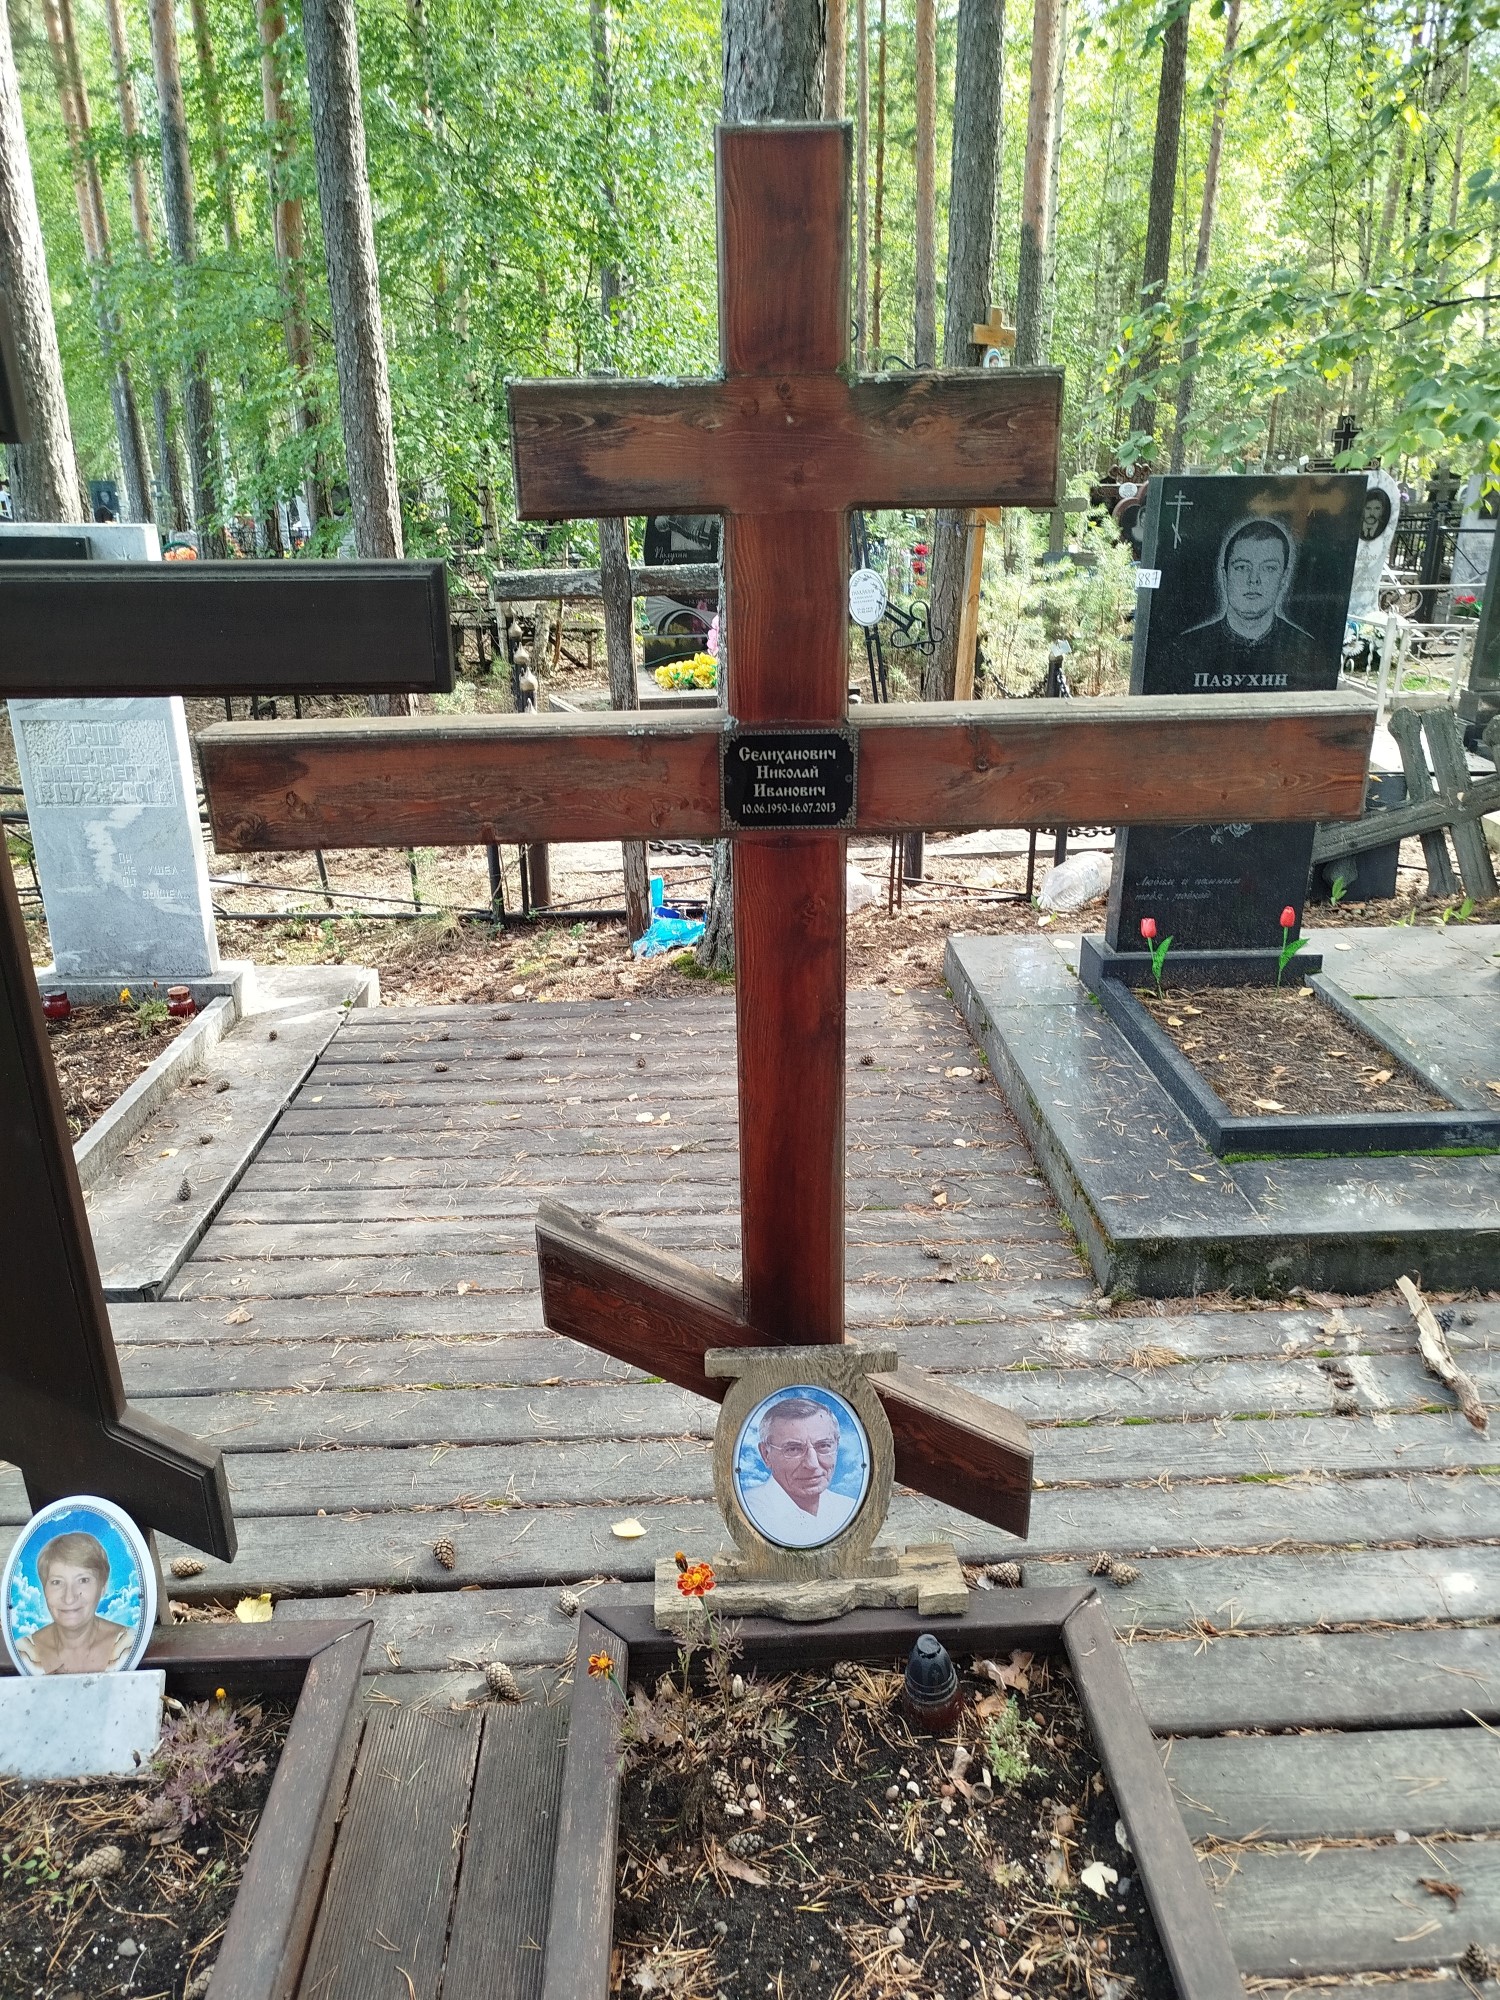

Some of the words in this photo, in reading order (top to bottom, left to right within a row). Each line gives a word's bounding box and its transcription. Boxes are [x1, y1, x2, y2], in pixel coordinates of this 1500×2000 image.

[1193, 672, 1289, 688] ПАЗУХИН
[738, 747, 837, 764] Селиханович
[756, 765, 819, 780] Николай
[754, 783, 826, 798] Иванович
